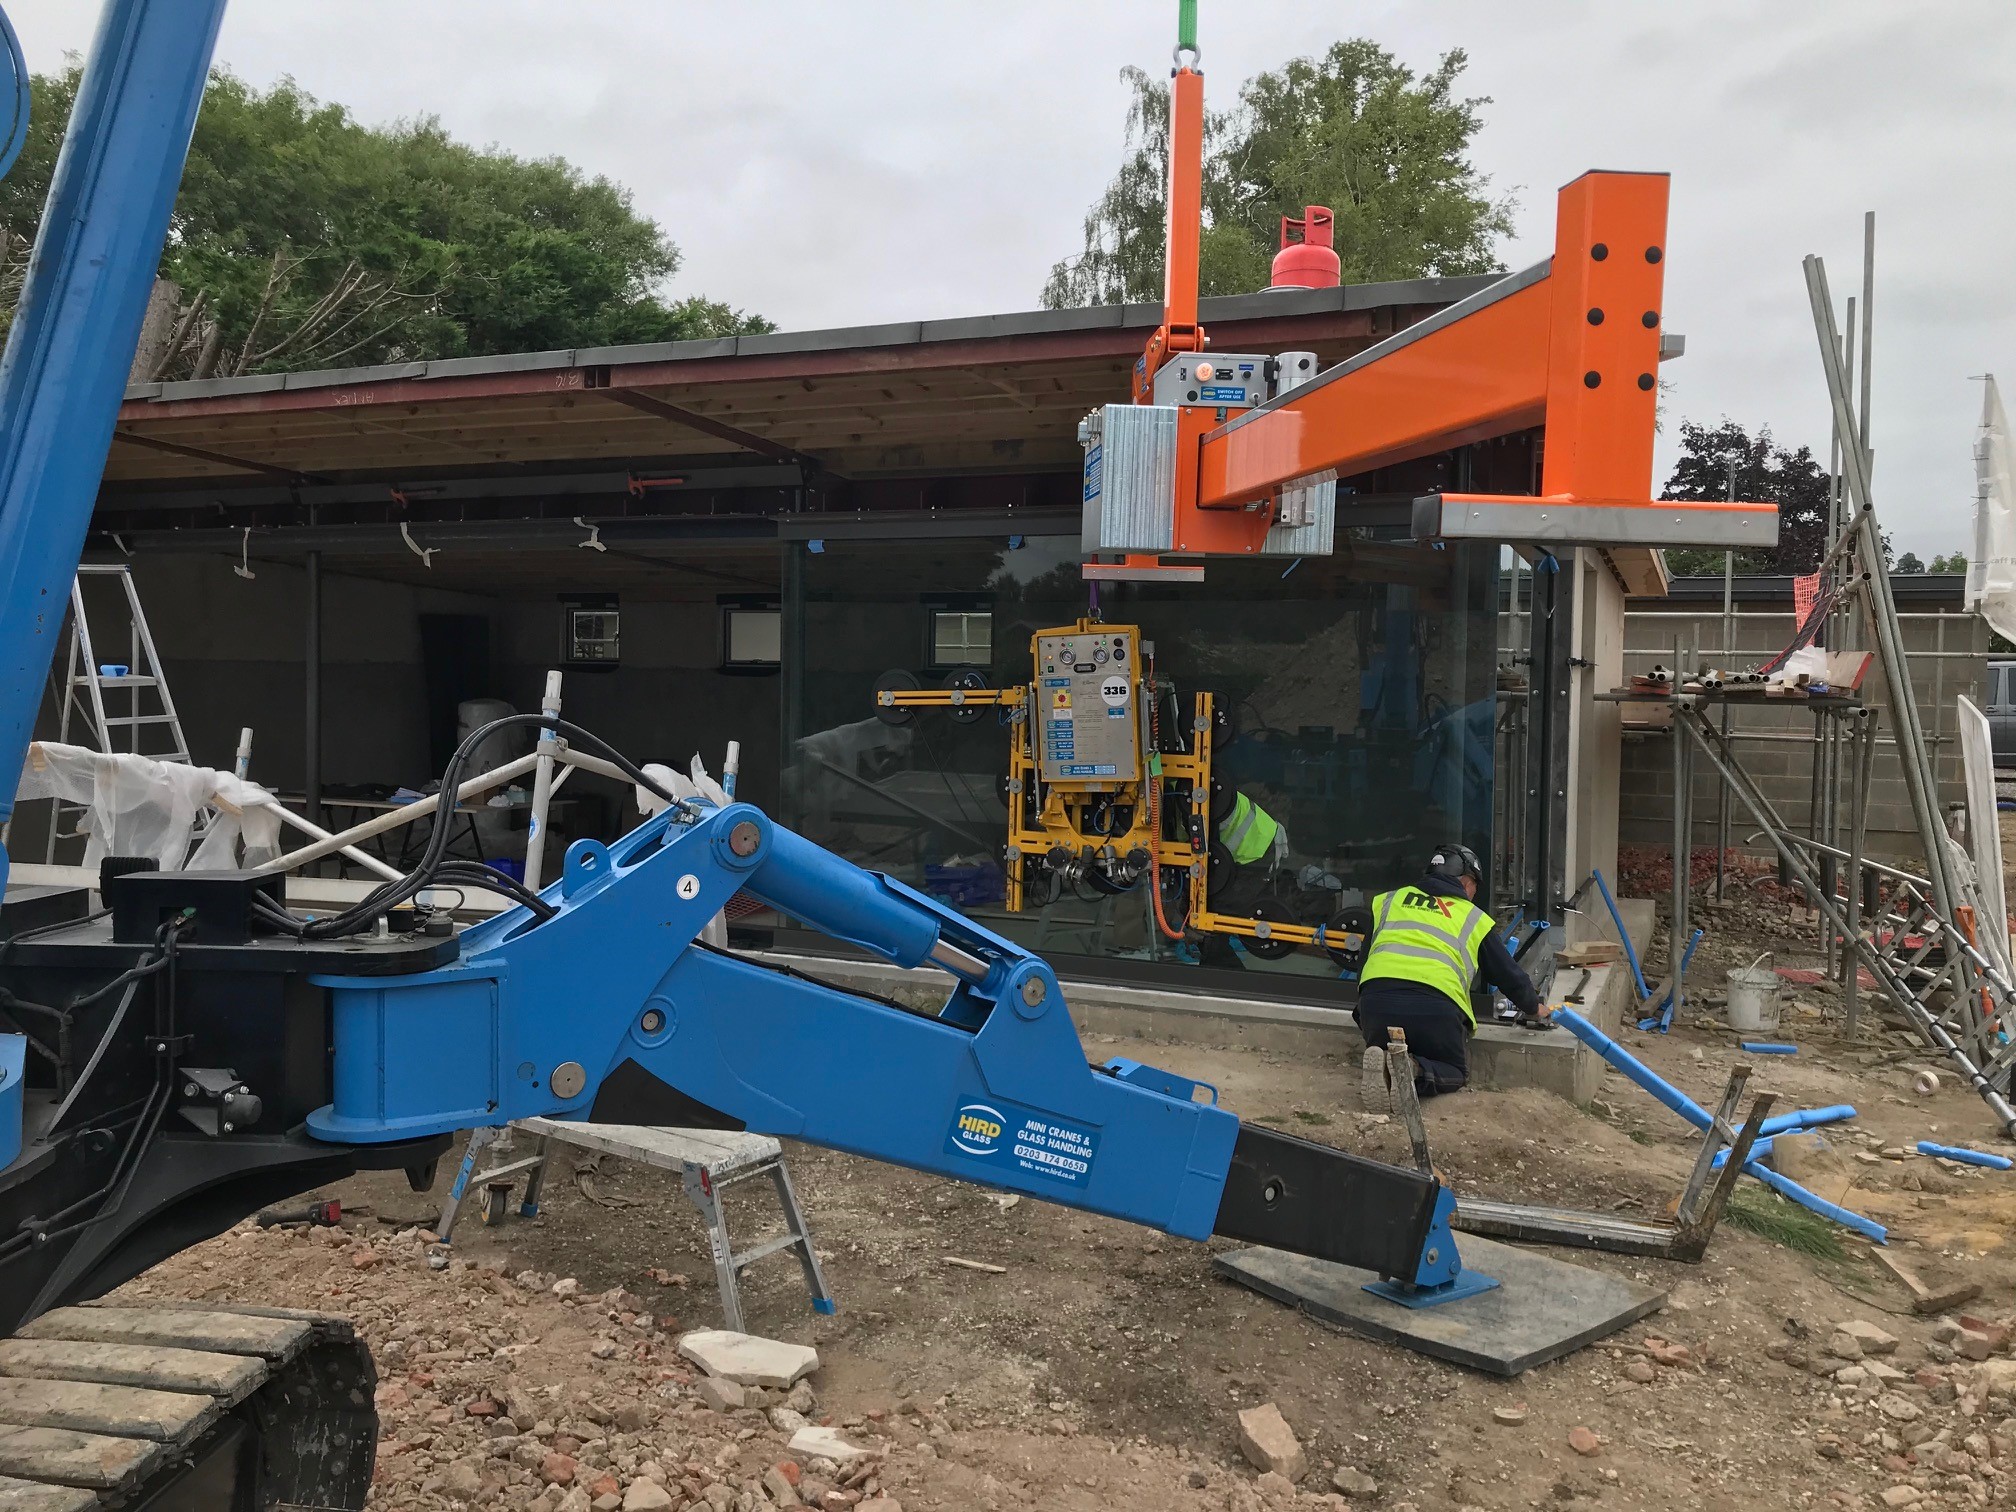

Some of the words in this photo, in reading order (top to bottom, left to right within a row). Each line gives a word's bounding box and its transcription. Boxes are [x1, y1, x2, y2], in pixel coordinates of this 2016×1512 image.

[1104, 686, 1126, 695] 336
[683, 881, 692, 893] 4
[958, 1115, 1001, 1138] HIRD
[1025, 1120, 1046, 1133] MINI
[1049, 1126, 1081, 1142] CRANES
[1084, 1136, 1090, 1146] &
[963, 1132, 991, 1145] GLASS
[1017, 1129, 1045, 1145] GLASS
[1048, 1138, 1092, 1158] HANDLING
[1017, 1146, 1040, 1160] 0203
[1044, 1152, 1059, 1165] 174
[1062, 1159, 1085, 1172] 0658
[1020, 1159, 1034, 1169] Web:
[1035, 1164, 1076, 1181] www.hird.co.uk
